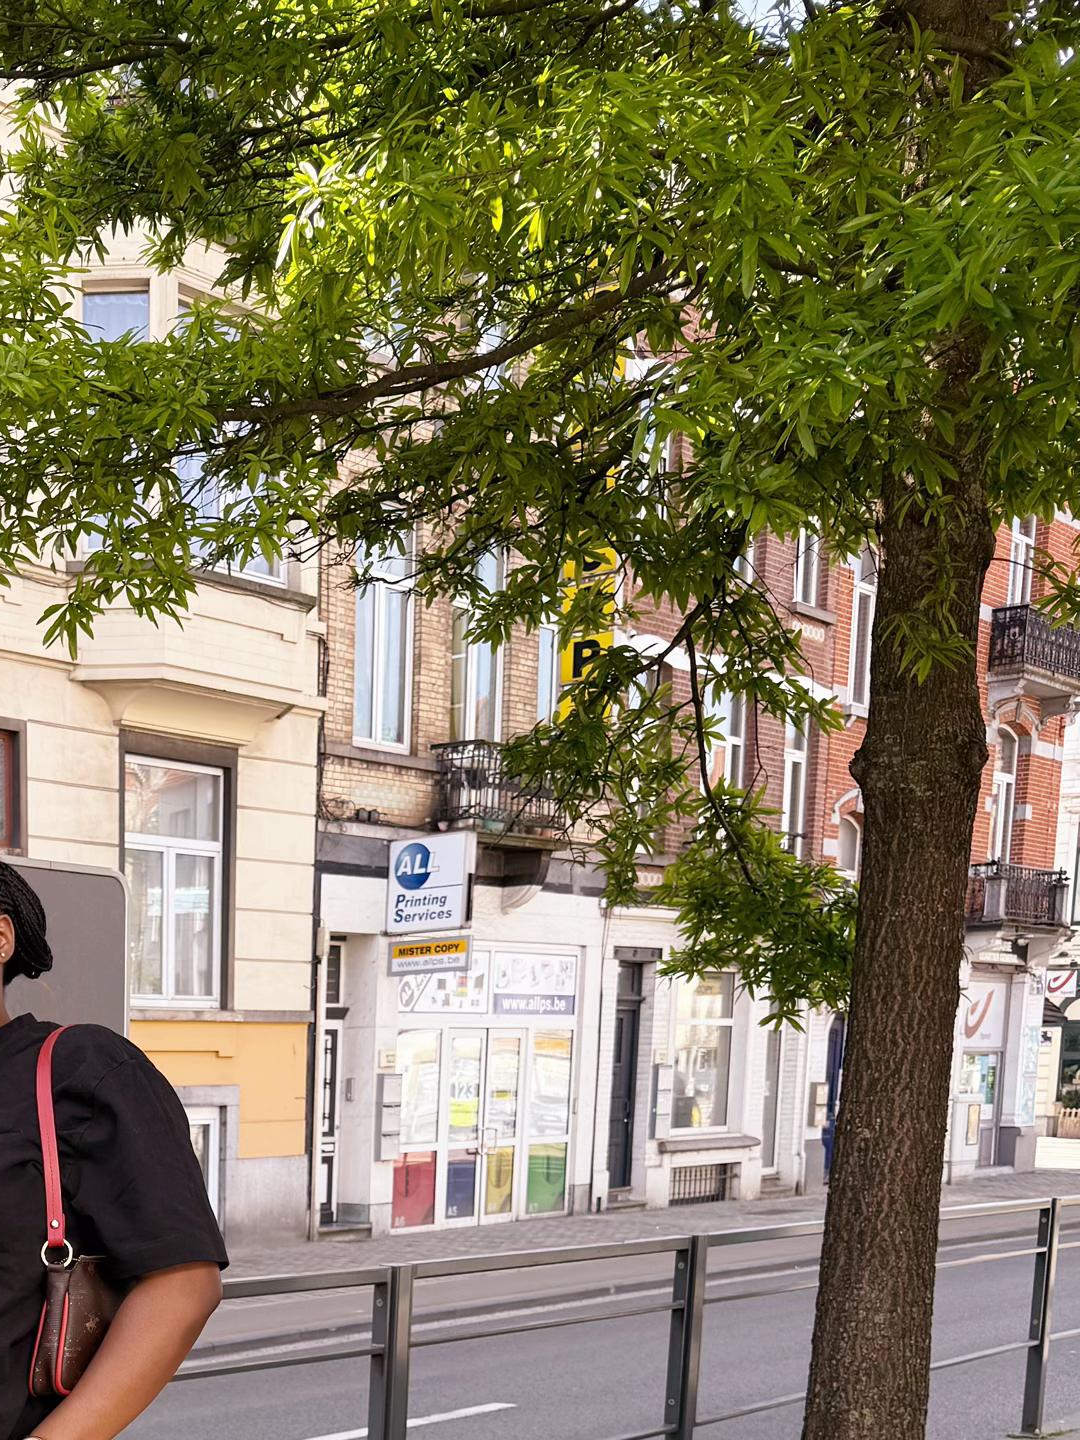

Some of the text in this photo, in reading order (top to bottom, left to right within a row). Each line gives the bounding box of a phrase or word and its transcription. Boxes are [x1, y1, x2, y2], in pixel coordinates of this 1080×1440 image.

[397, 851, 440, 877] ALL
[395, 894, 447, 909] Printing
[394, 908, 452, 923] Services
[398, 943, 460, 957] MISTER COPY
